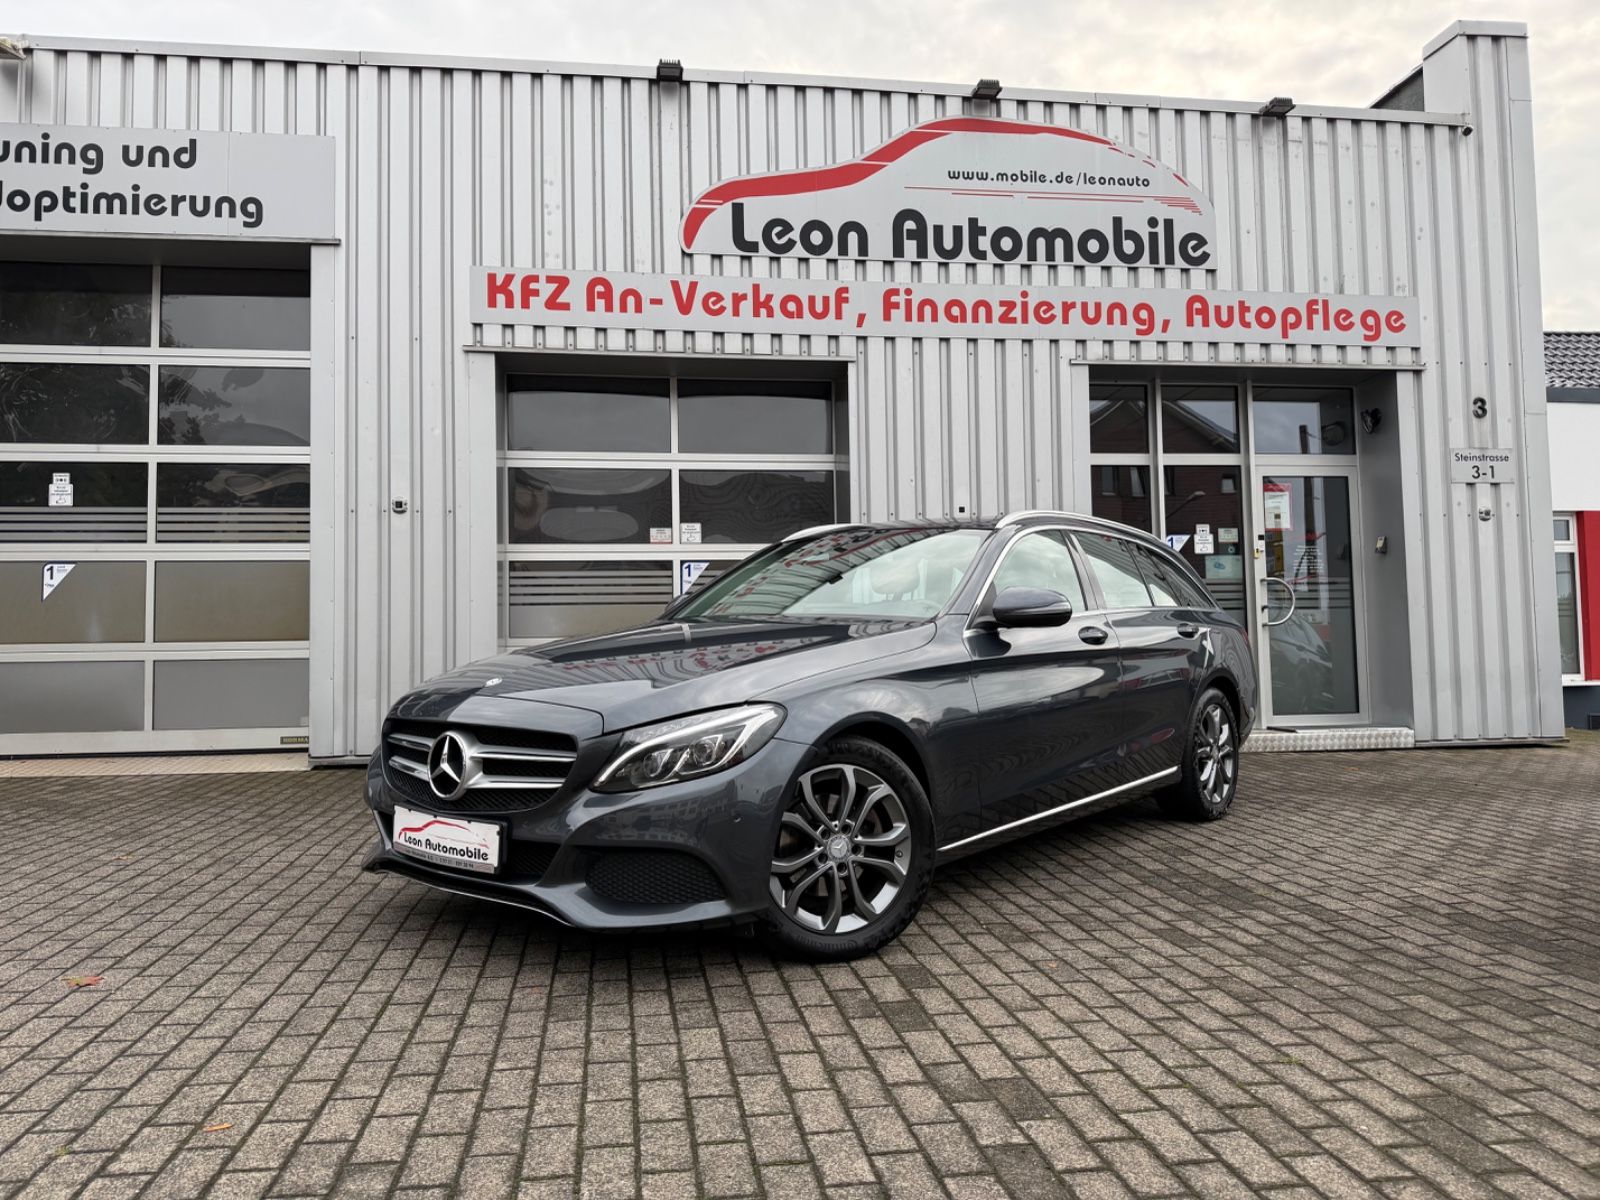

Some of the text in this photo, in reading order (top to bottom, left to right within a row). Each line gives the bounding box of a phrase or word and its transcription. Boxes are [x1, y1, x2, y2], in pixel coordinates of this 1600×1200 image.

[122, 138, 197, 169] und
[947, 169, 1151, 188] www.mobile.de/leonauto
[0, 180, 263, 228] optimierung
[731, 202, 1211, 267] Leon Automobile
[585, 276, 866, 328] An-Verkauf,
[882, 288, 1171, 337] Finanzierung,
[1185, 294, 1407, 343] Autopflege
[1472, 397, 1488, 419] 3
[1454, 453, 1510, 462] Steinstrasse
[1471, 465, 1496, 479] 3-1
[46, 566, 54, 580] 1
[684, 563, 691, 577] 1
[403, 832, 423, 848] Leon
[425, 838, 489, 861] Automobile
